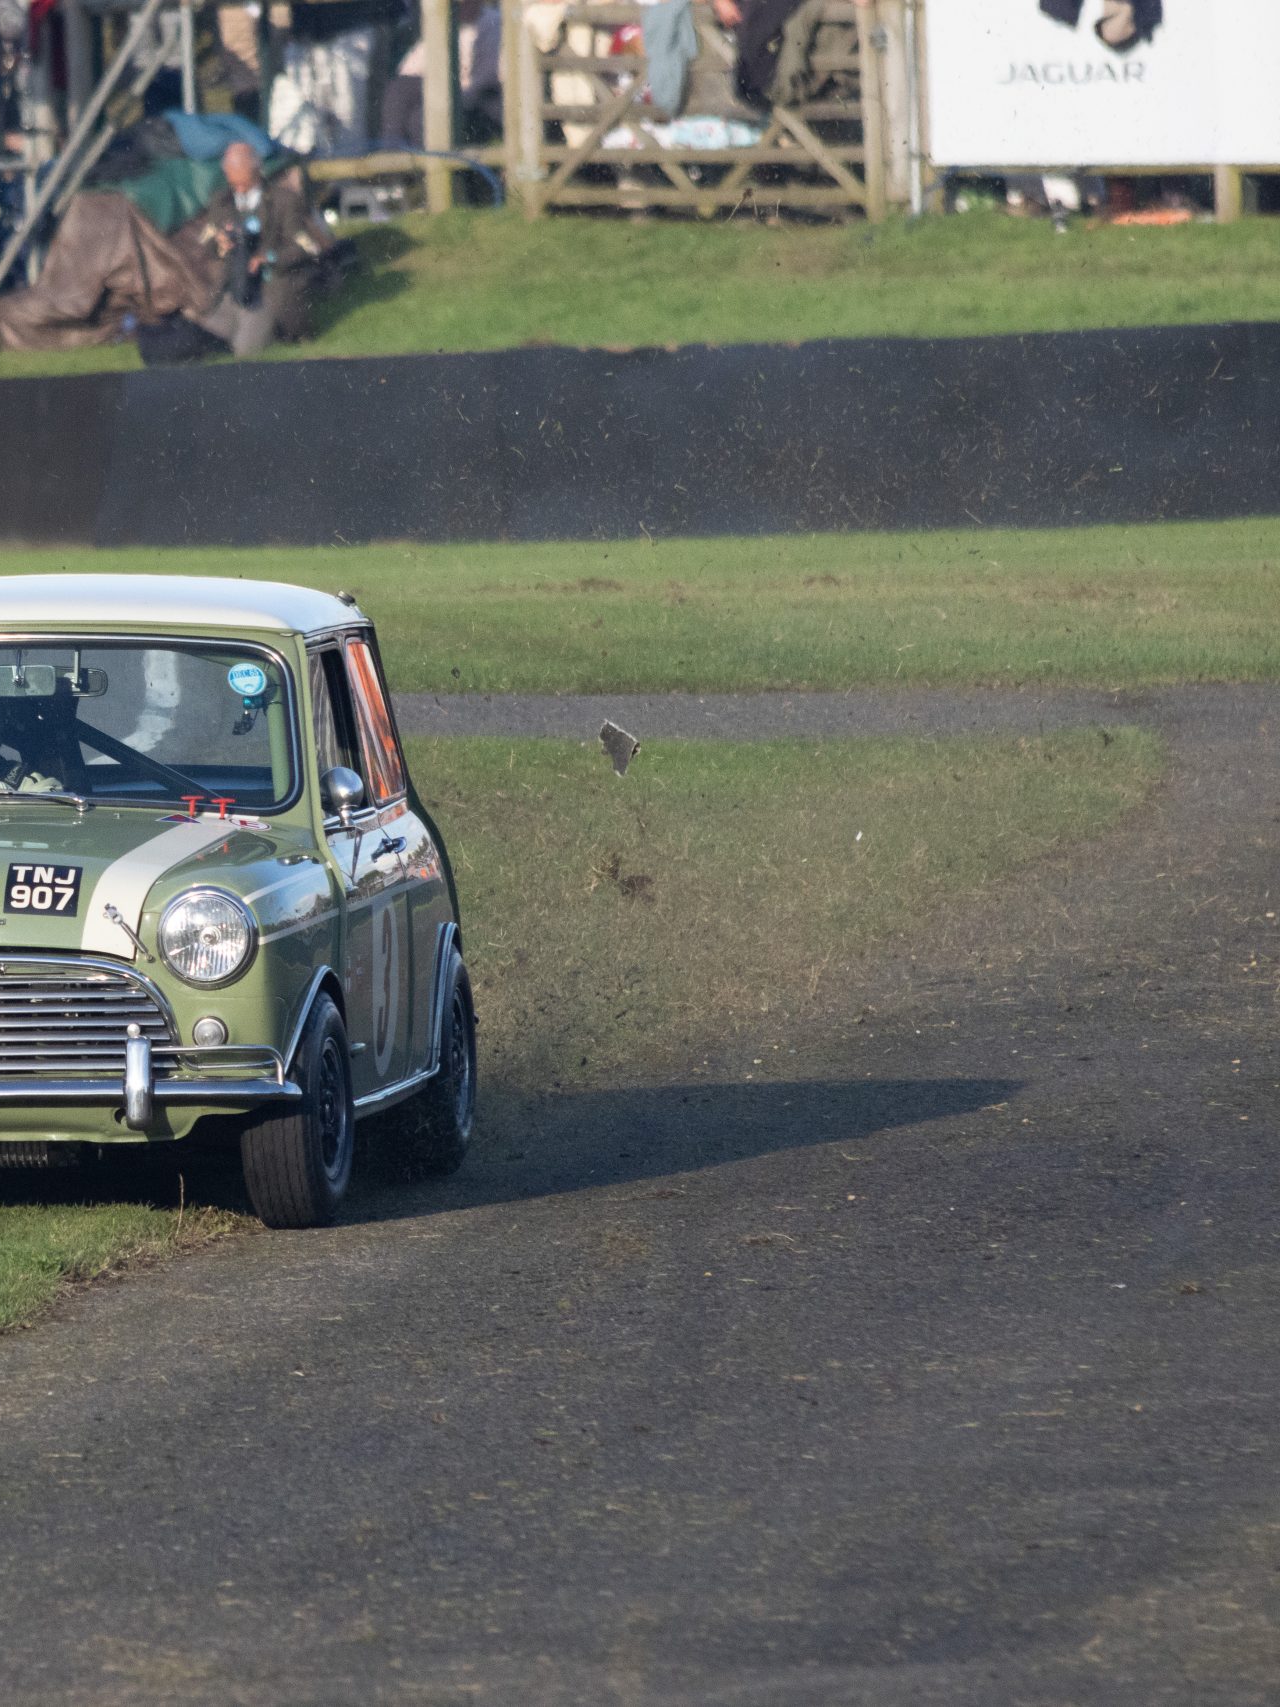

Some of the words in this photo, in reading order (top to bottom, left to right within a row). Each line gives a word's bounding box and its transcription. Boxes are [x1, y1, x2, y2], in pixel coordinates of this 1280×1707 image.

[997, 60, 1147, 86] JAGUAR
[12, 865, 77, 885] TNJ
[10, 884, 75, 911] 907
[376, 907, 392, 1057] 3
